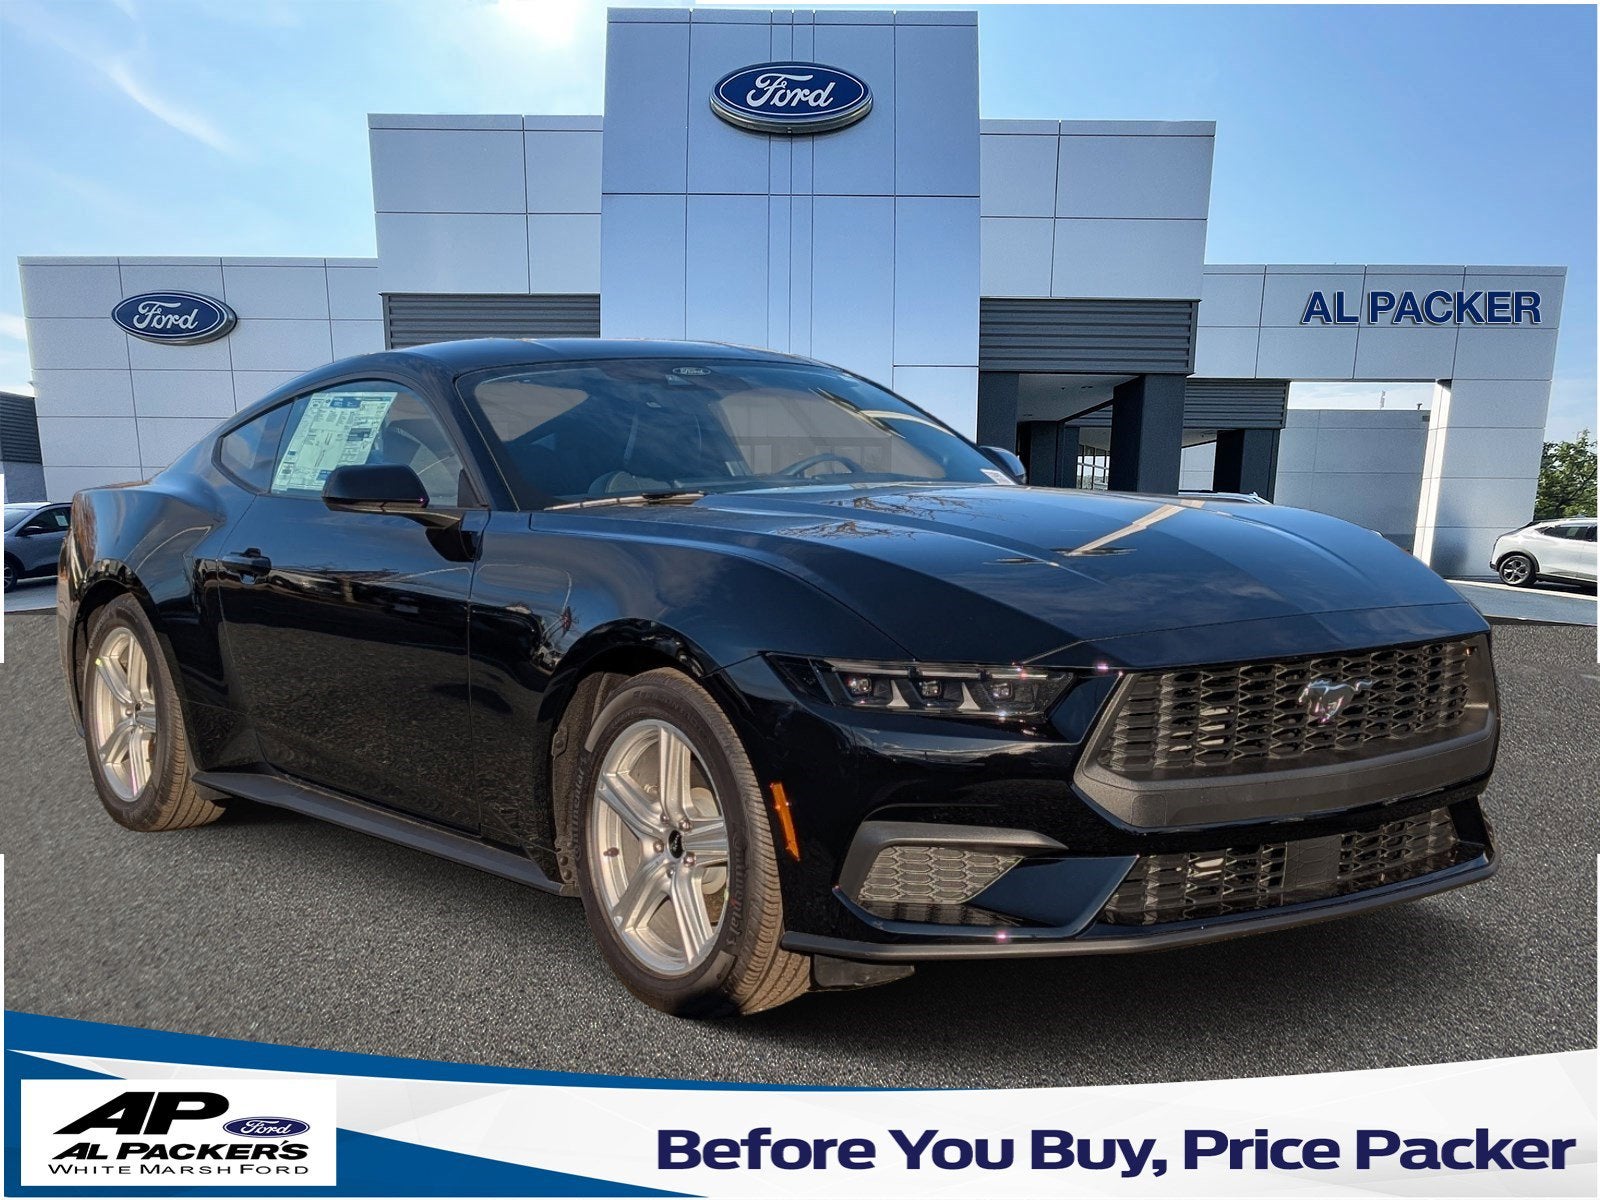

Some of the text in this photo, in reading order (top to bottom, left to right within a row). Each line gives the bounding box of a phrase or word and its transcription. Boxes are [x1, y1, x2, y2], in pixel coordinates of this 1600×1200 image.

[746, 73, 836, 107] Ford
[133, 301, 199, 329] Ford
[1301, 290, 1543, 325] AL PACKER
